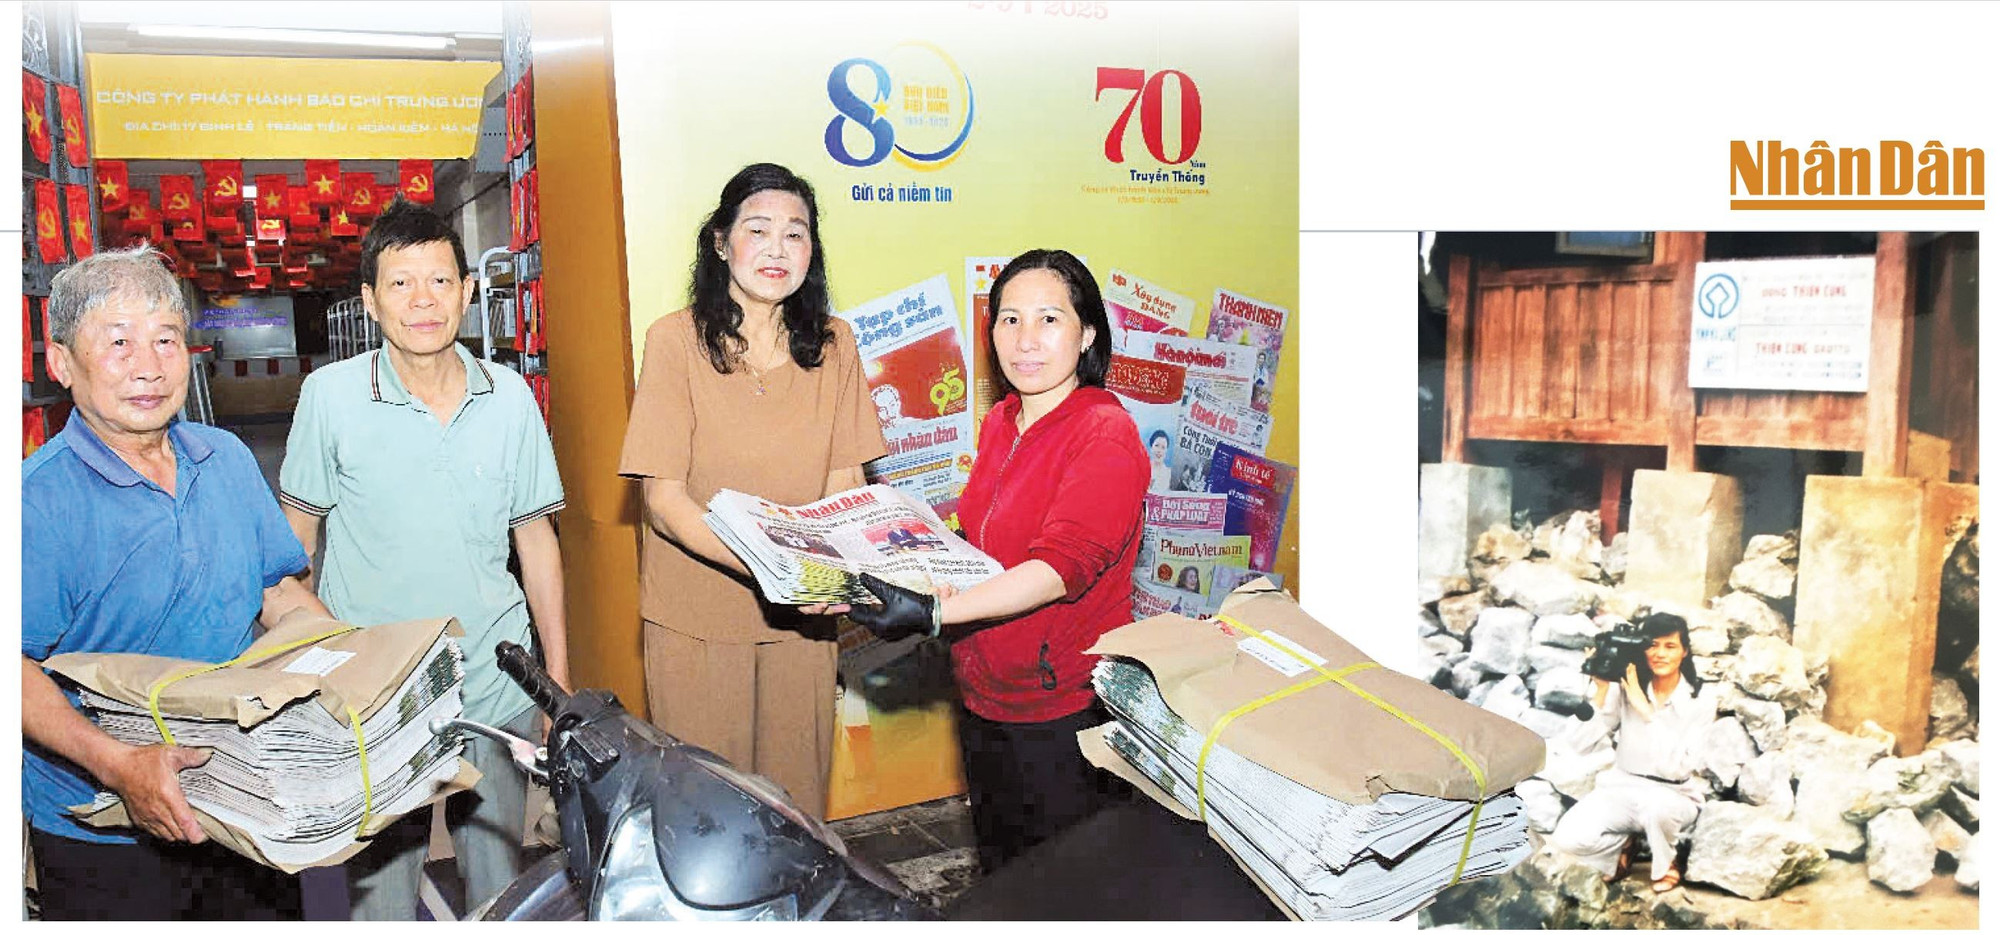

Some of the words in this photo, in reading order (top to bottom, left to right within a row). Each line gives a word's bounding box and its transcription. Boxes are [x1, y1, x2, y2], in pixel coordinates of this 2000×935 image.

[160, 92, 185, 105] TY
[384, 94, 449, 108] TRUNG
[1095, 67, 1202, 164] 70
[1130, 168, 1169, 184] Truyền
[1171, 168, 1205, 185] Thống
[851, 182, 874, 201] Gửi
[878, 183, 894, 201] cả
[898, 181, 931, 202] niềm
[935, 185, 953, 203] tin
[929, 367, 965, 416] 95
[1151, 506, 1161, 521] &
